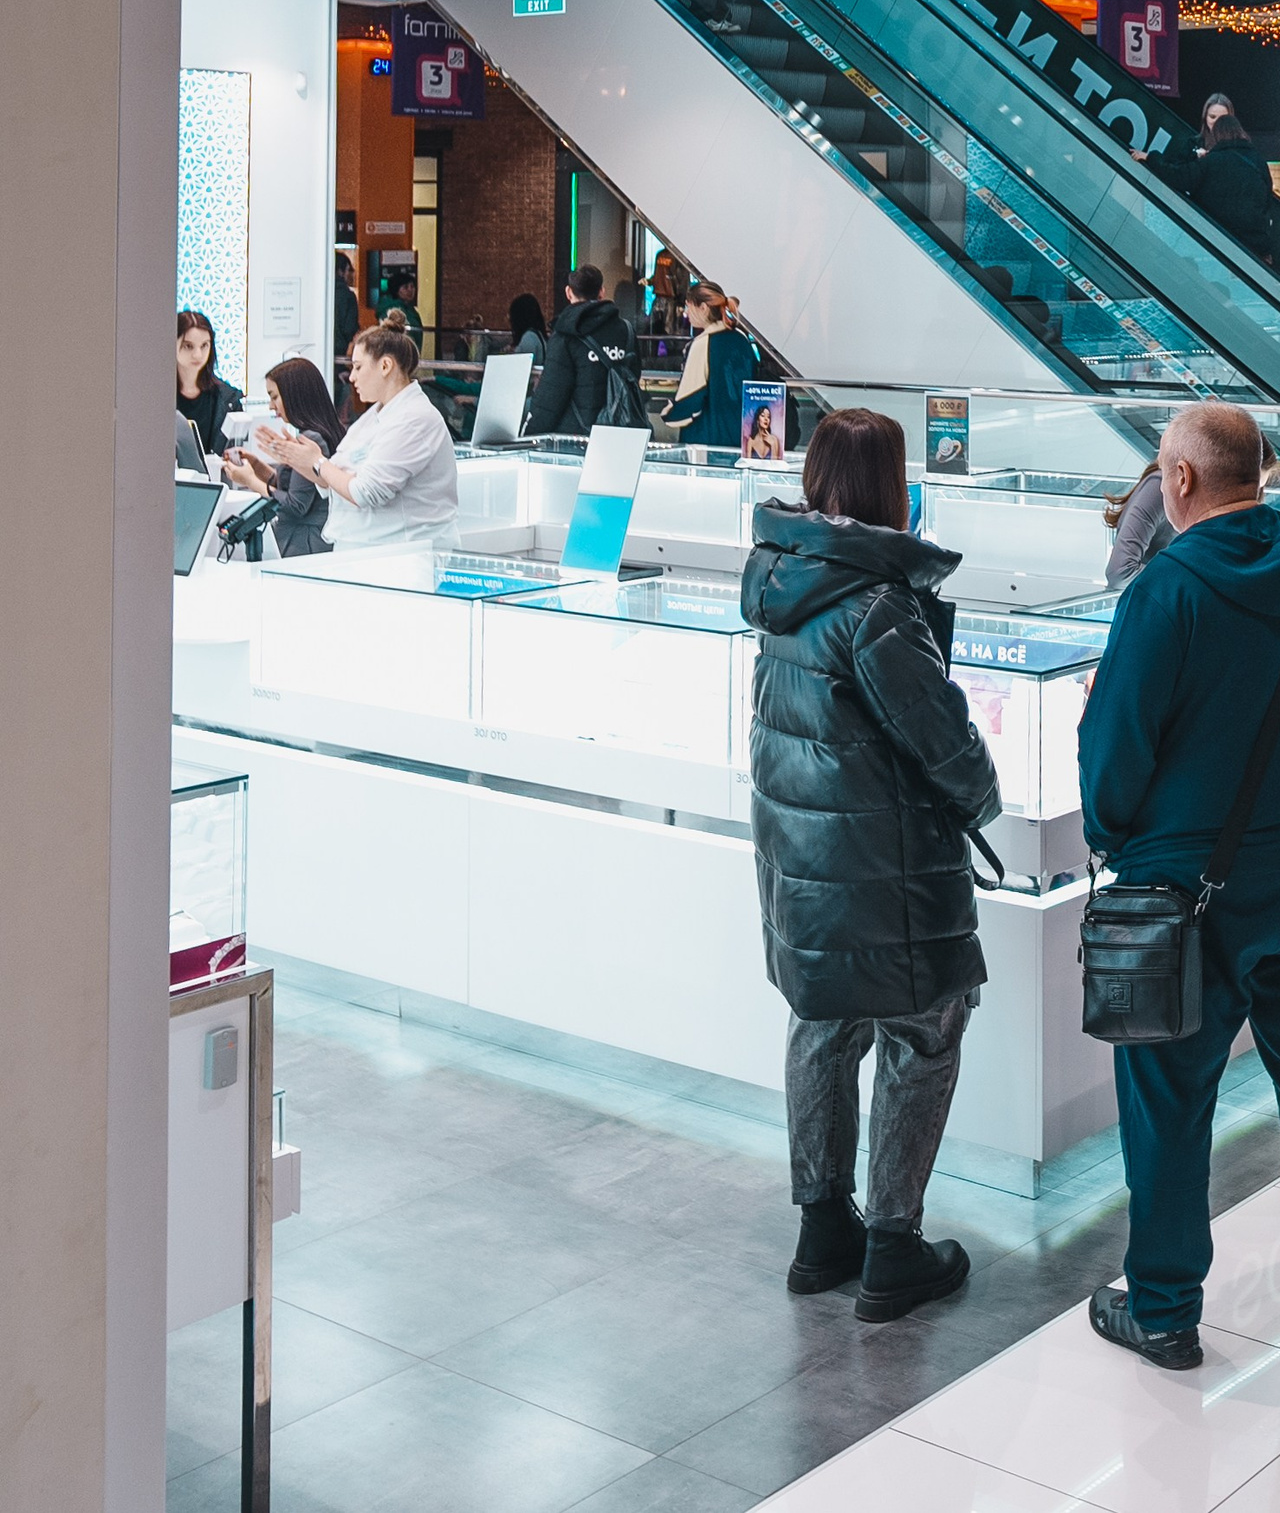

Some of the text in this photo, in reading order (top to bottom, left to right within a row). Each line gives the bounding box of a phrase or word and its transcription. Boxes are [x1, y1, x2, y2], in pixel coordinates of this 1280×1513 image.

[527, 0, 550, 12] EXIT
[1130, 26, 1143, 52] 3
[429, 64, 443, 86] 3
[939, 402, 956, 411] 000
[438, 573, 504, 589] СЕРЕБРЯНЫЕ ЦЕПИ
[667, 600, 725, 616] ЗОЛОТЫЕ ЦЕПИ
[971, 643, 993, 661] НА
[997, 644, 1027, 664] ВСЁ
